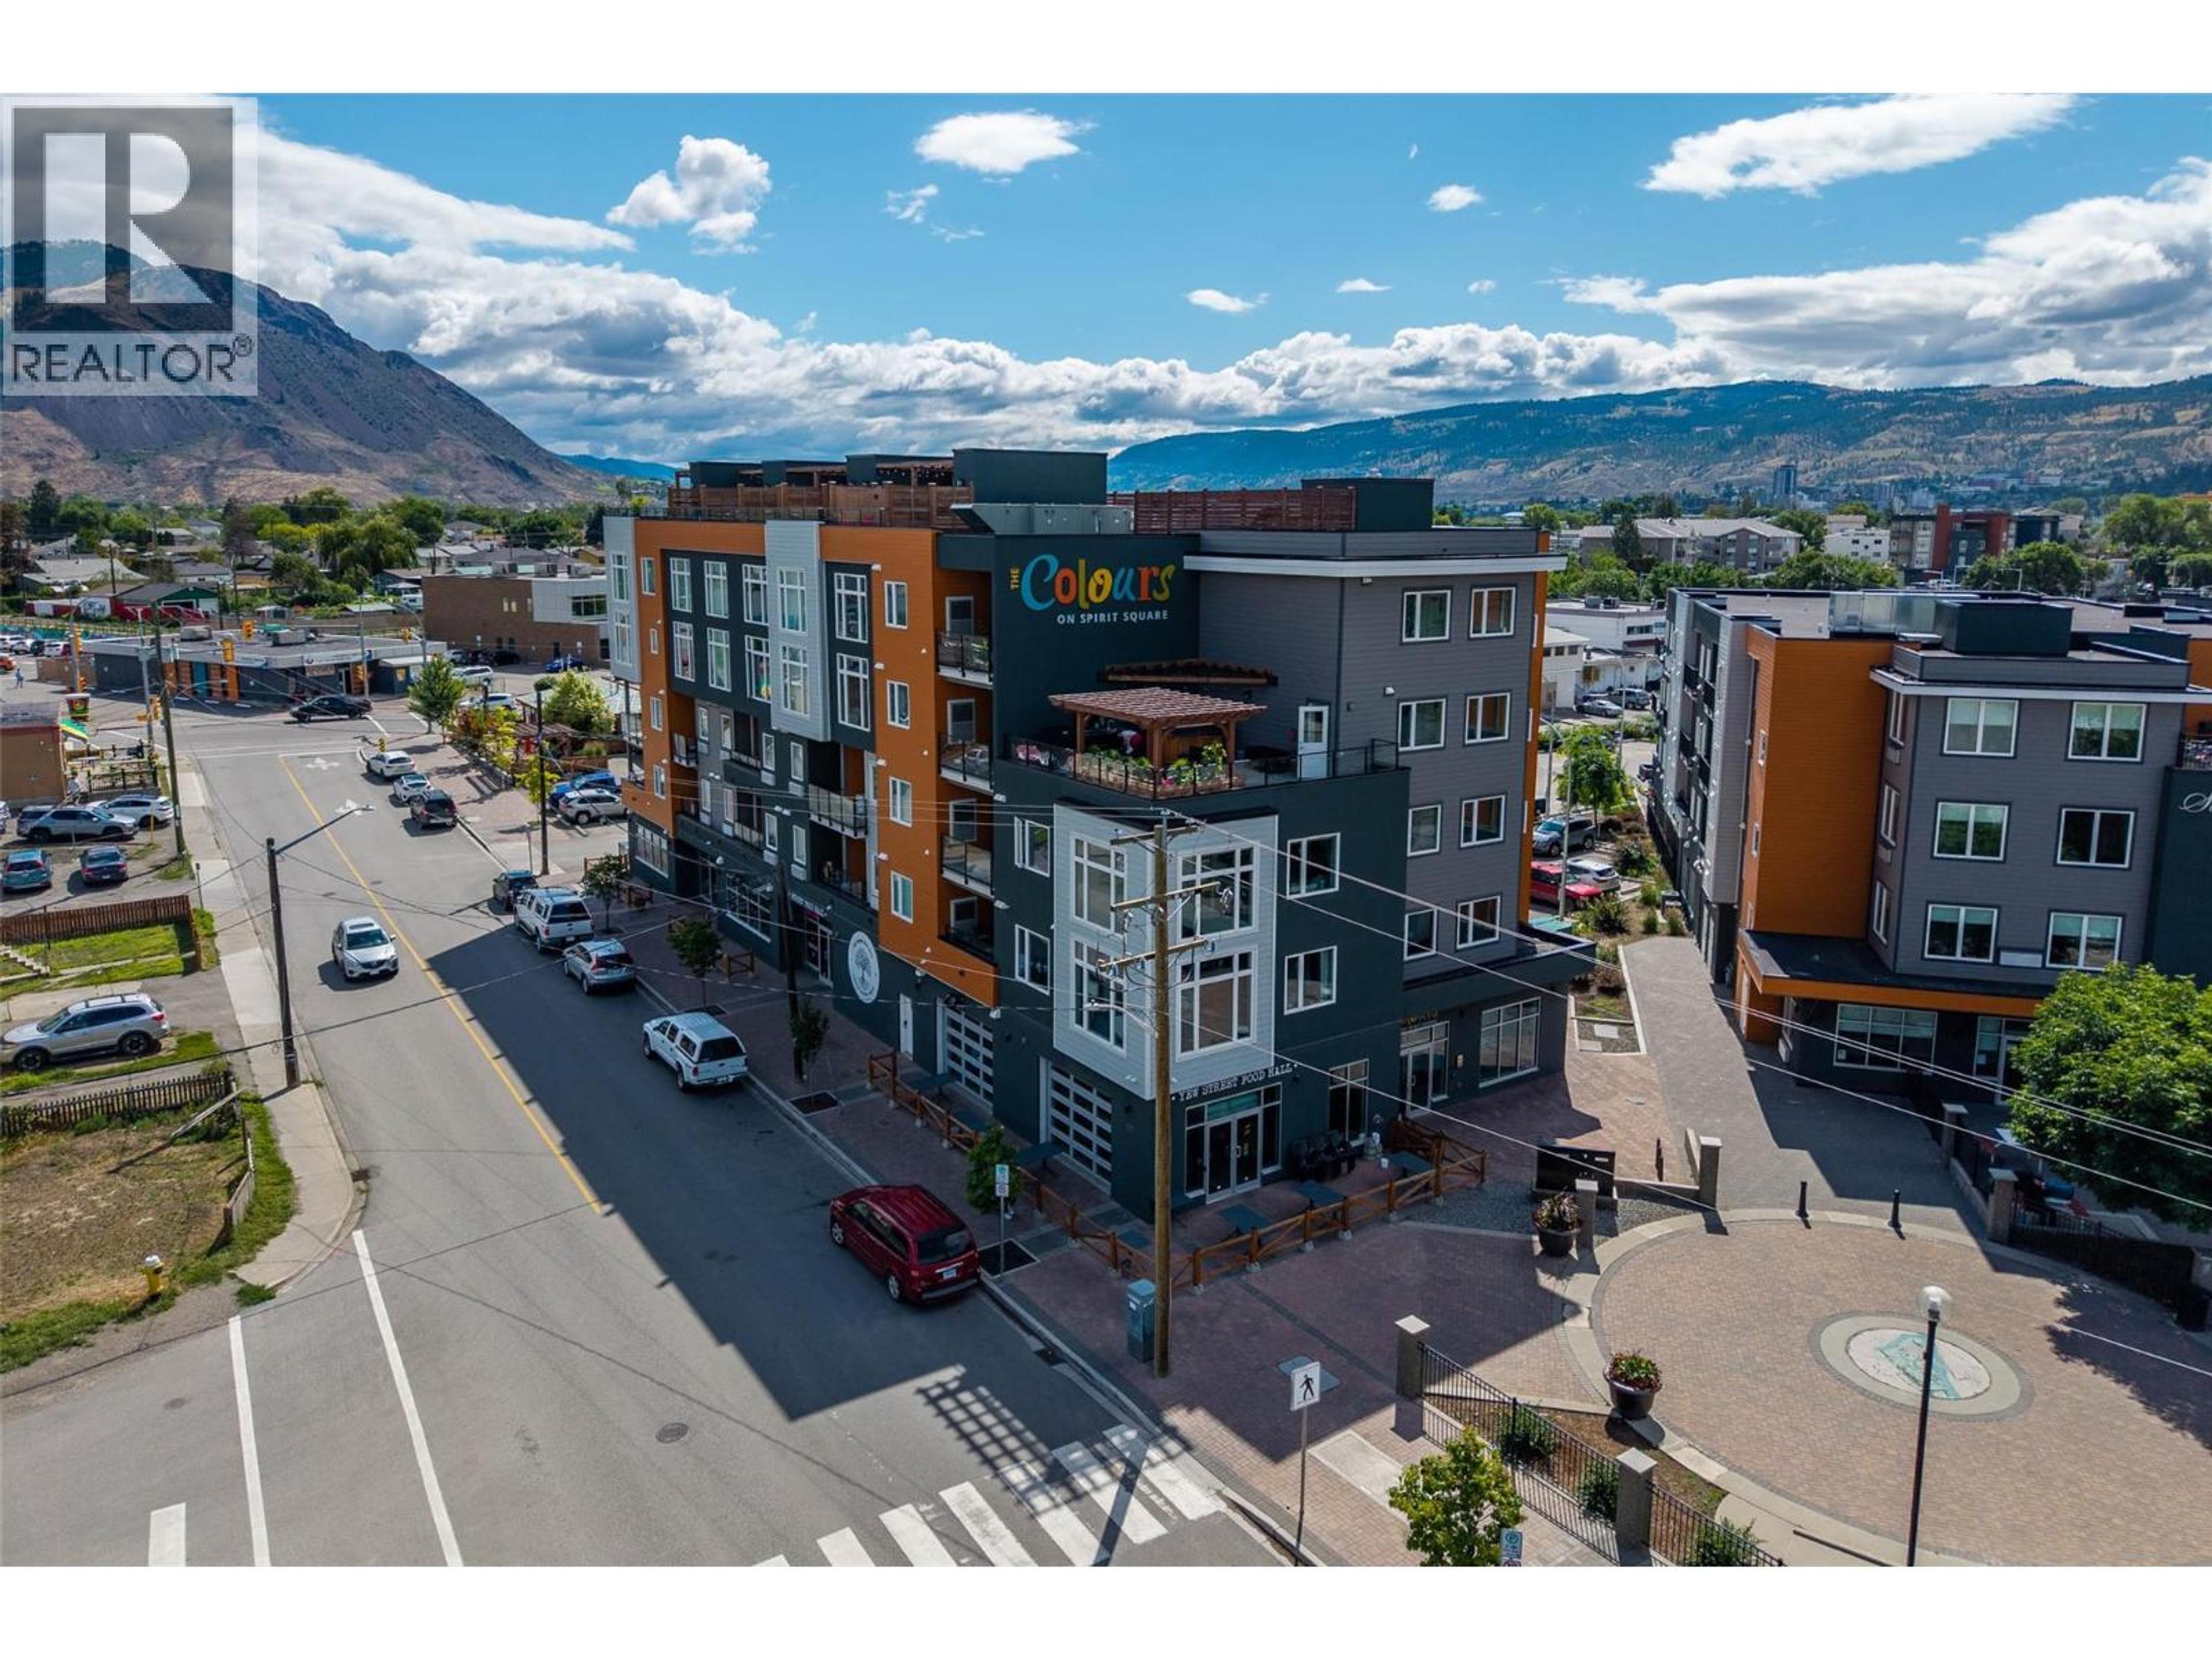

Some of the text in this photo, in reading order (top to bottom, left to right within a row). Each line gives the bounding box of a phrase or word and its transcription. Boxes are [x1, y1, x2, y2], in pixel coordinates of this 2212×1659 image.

[1010, 554, 1176, 611] THE Colours
[1056, 609, 1168, 624] ON SPIRIT SQUARE
[1241, 1071, 1266, 1085] FOOD
[1267, 1063, 1293, 1078] HALL
